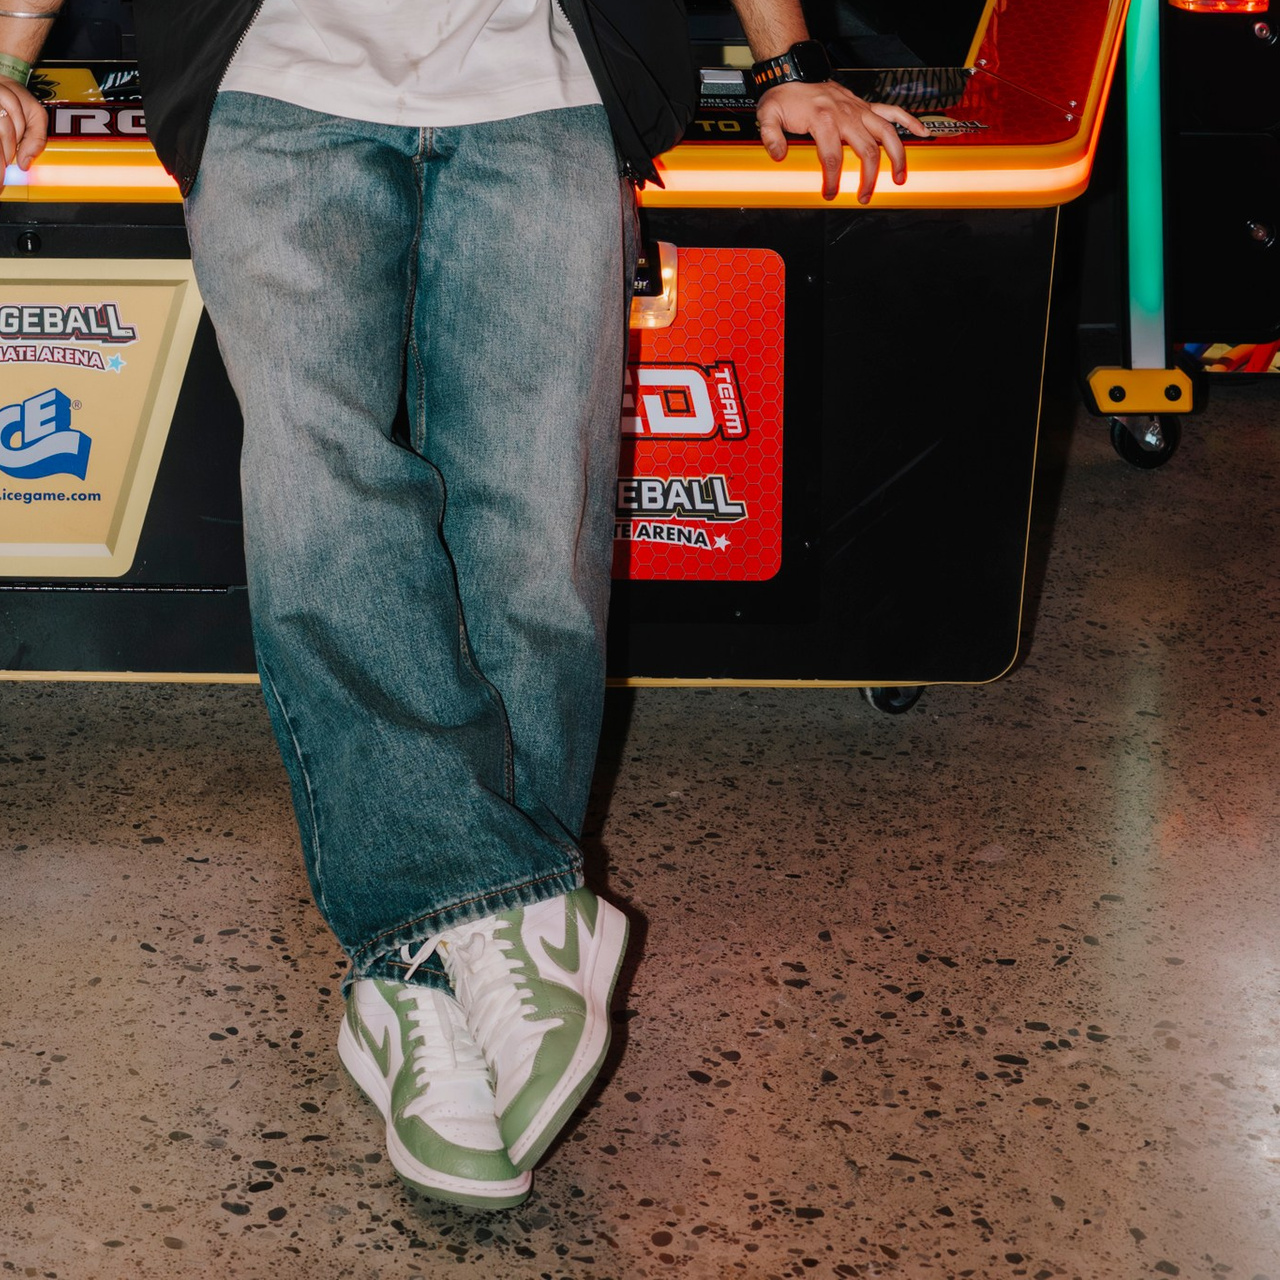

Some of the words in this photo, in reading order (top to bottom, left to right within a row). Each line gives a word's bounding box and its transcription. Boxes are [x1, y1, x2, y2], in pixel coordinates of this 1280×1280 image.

[694, 120, 741, 132] TO
[38, 345, 105, 369] ARENA
[713, 366, 744, 436] TEAM
[619, 474, 744, 514] EBALL
[635, 523, 709, 548] ARENA
